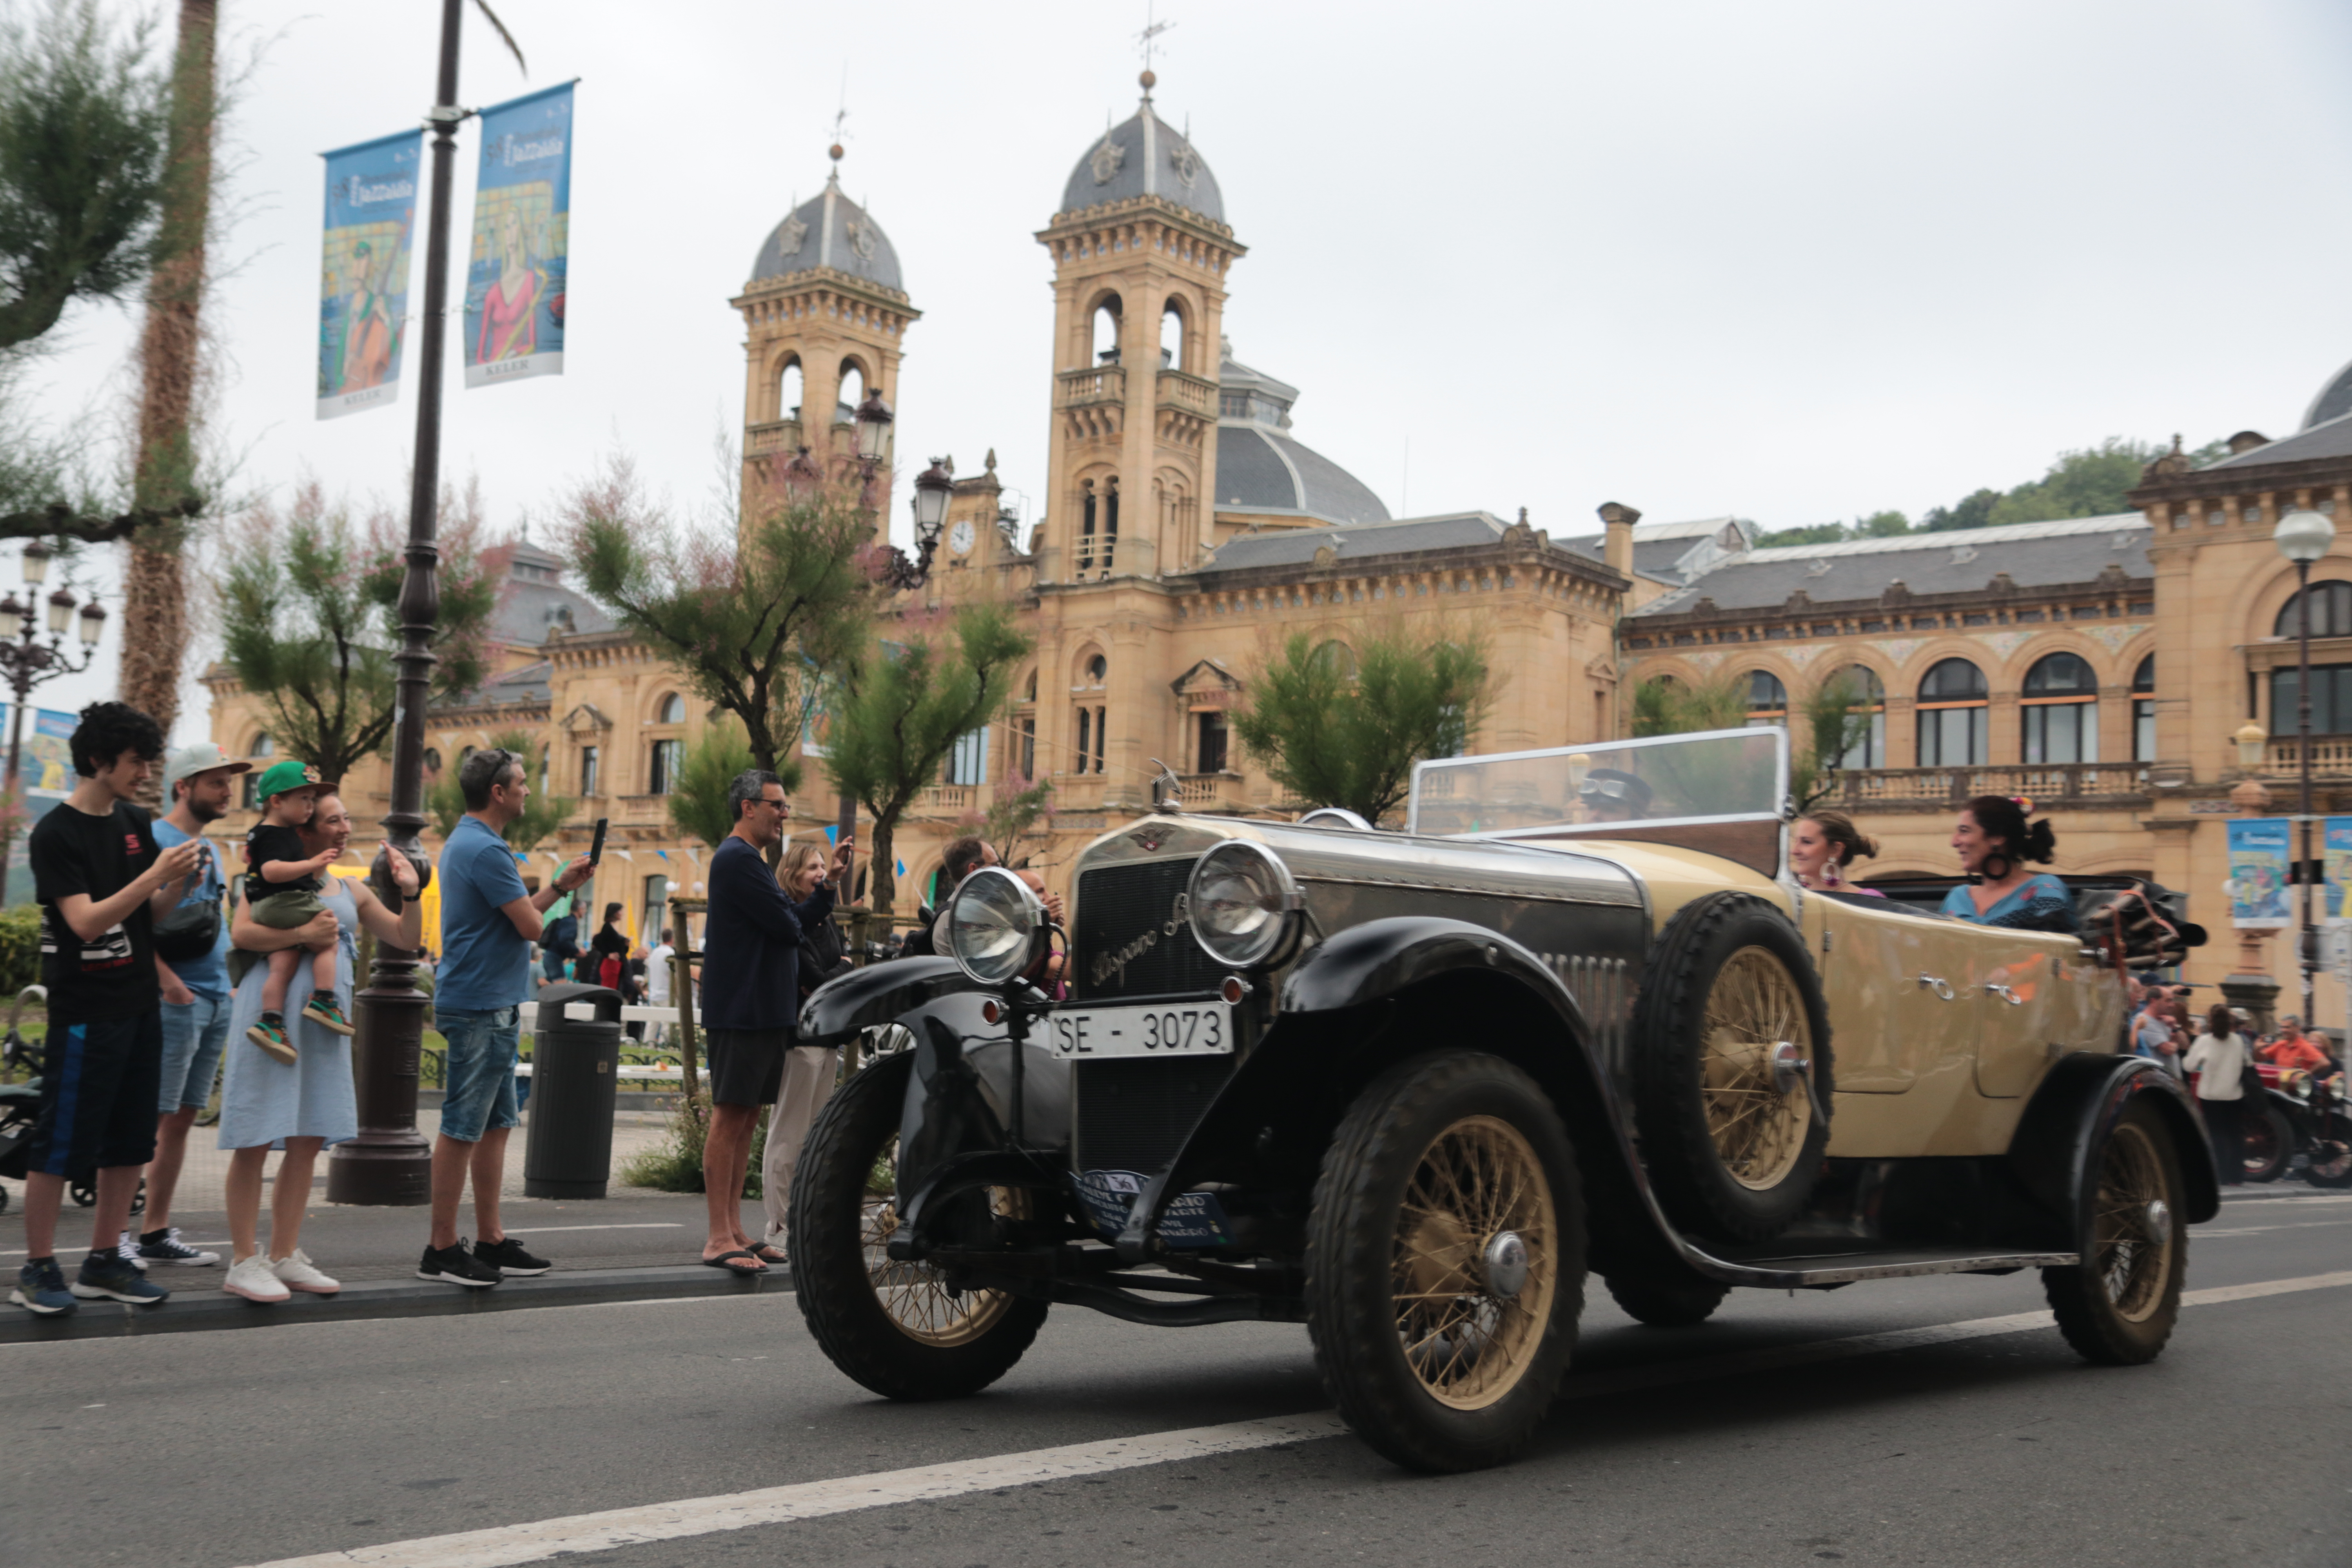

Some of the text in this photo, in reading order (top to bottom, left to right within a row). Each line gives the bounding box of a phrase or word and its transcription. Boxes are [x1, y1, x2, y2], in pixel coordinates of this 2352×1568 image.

[1058, 1016, 1093, 1053] SE
[1143, 1010, 1222, 1050] 3073
[1108, 1175, 1134, 1191] 36
